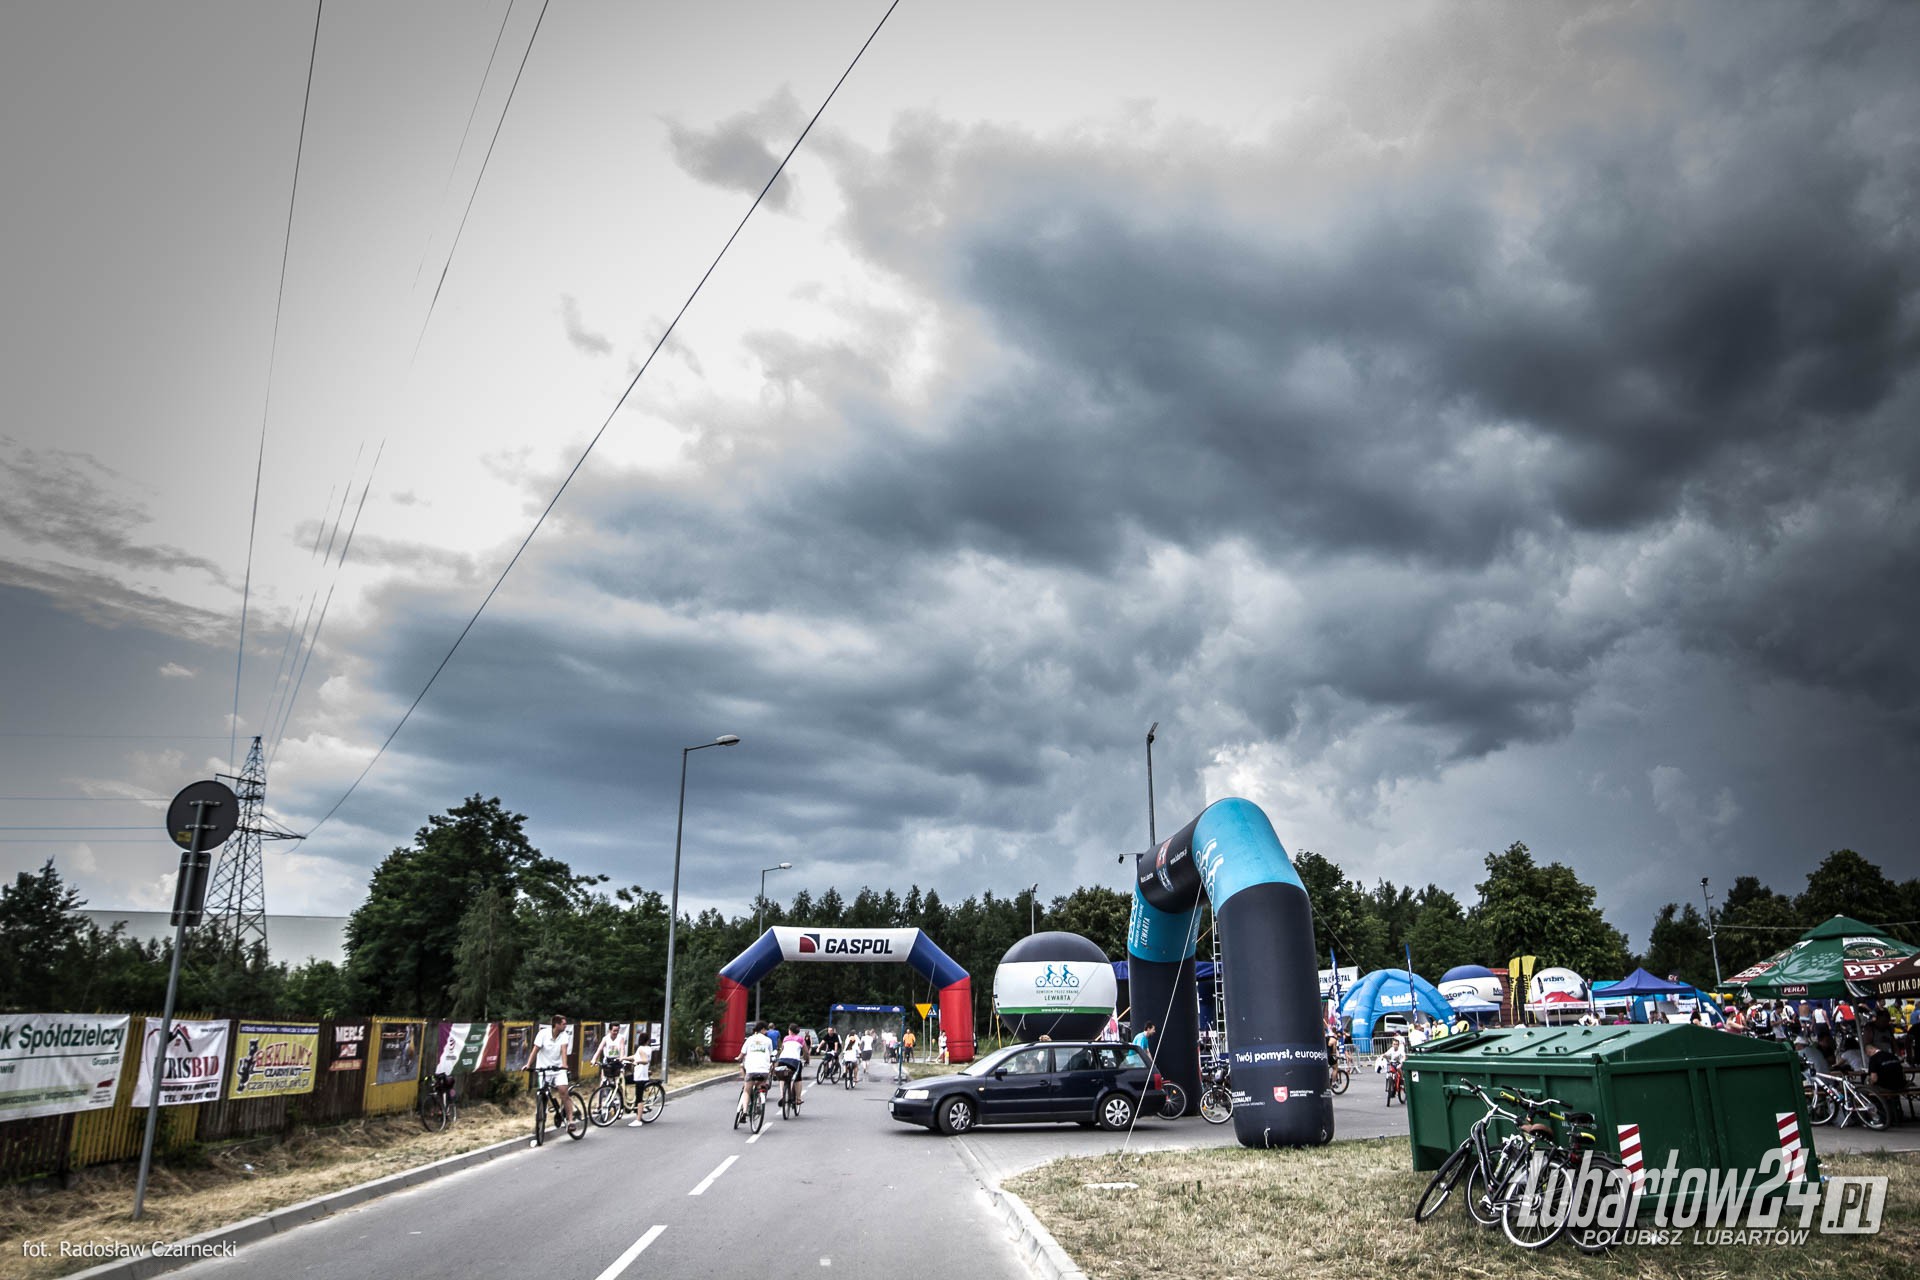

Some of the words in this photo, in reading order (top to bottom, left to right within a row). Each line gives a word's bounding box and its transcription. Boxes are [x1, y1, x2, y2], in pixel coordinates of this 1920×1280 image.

[1140, 917, 1151, 946] LEWARTA
[825, 938, 893, 954] GASPOL
[1897, 979, 1911, 991] JAK
[18, 1023, 125, 1054] Spółdzielczy
[335, 1026, 365, 1042] MEBLE
[255, 1043, 312, 1067] REKLAMY
[1235, 1052, 1253, 1063] Twój
[1255, 1048, 1293, 1063] pomysł,
